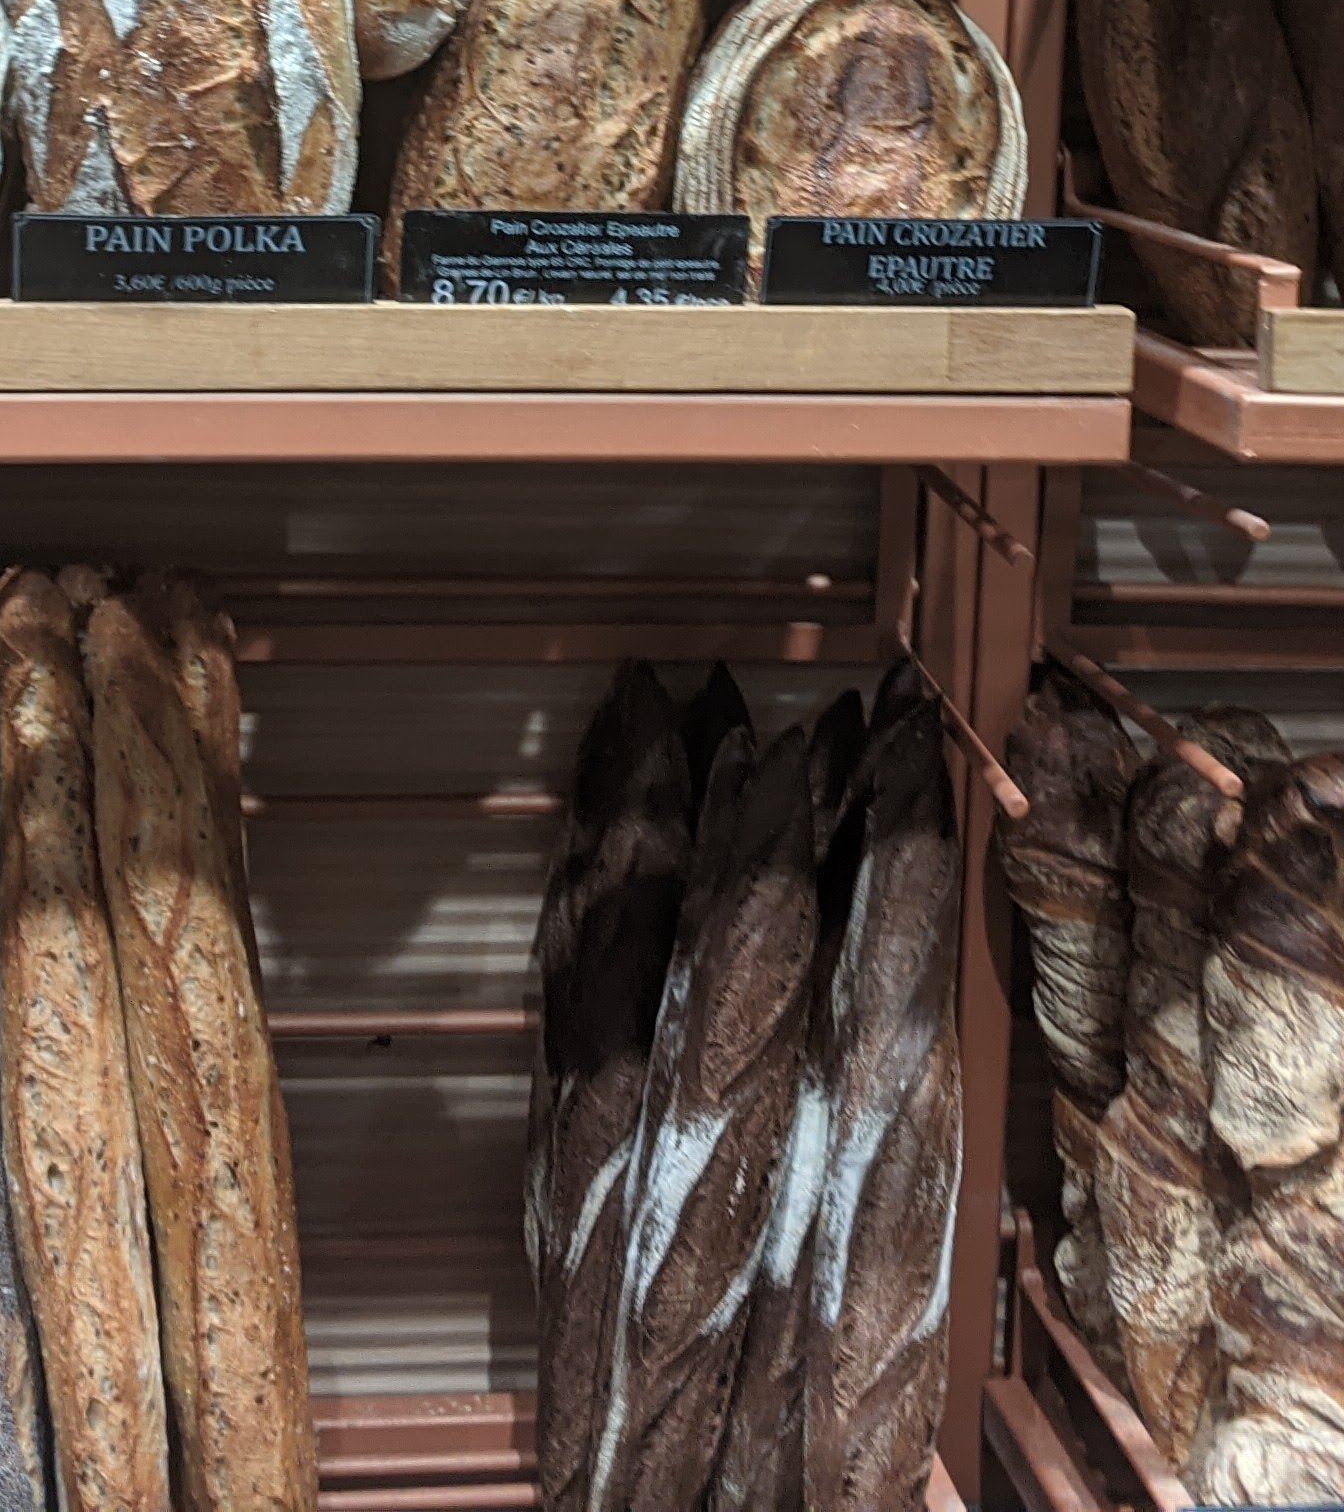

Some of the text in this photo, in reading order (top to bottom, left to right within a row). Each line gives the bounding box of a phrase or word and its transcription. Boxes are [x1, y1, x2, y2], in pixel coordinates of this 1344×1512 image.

[84, 224, 306, 254] PAIN POLKA
[489, 218, 529, 236] Pain
[821, 220, 1047, 249] PAIN CROZATIER
[523, 239, 559, 255] Aux
[867, 253, 996, 281] EPAUTRE
